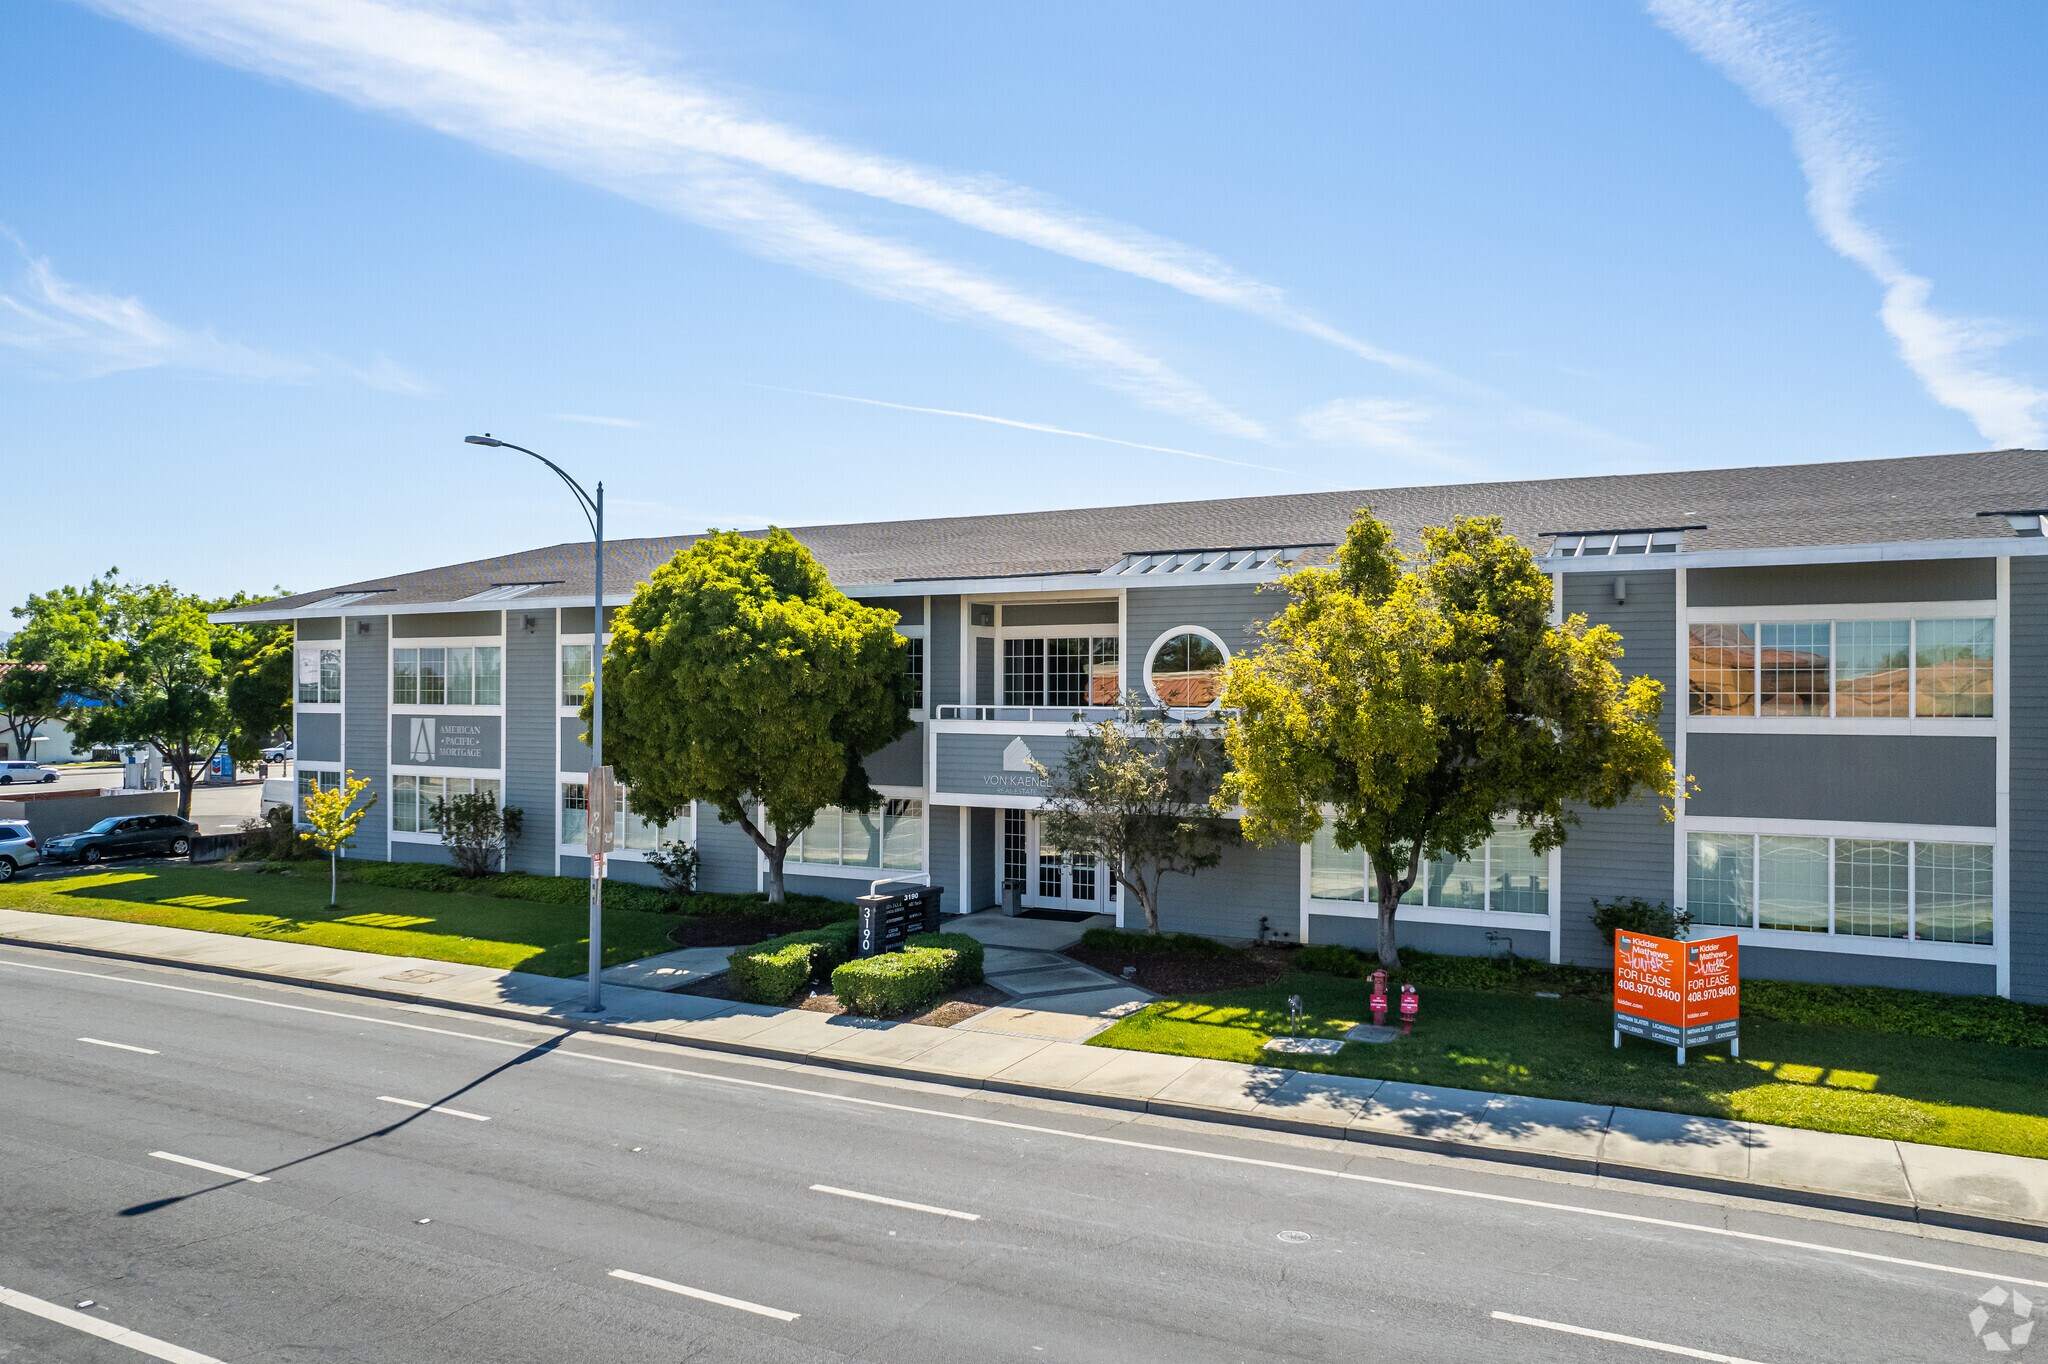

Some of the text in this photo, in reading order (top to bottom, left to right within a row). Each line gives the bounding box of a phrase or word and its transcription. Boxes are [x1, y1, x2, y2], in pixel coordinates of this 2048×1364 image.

[440, 725, 480, 734] AMERICAN
[445, 736, 475, 746] PACIFIC
[440, 747, 481, 757] MORTGAGE
[983, 775, 1052, 788] VON KAENEL
[1014, 788, 1038, 796] ESTATE
[903, 892, 919, 901] 3190
[862, 907, 871, 950] 3190
[1632, 937, 1658, 949] Kidder
[1700, 944, 1719, 952] Kidder
[1632, 945, 1669, 960] Mathews
[1700, 950, 1727, 961] Mathews
[1618, 967, 1671, 988] FOR LEASE
[1688, 974, 1729, 990] FOR LEASE
[1617, 979, 1681, 1002] 408.970.9400
[1687, 985, 1737, 1002] 408.970.9400
[1617, 998, 1643, 1010] kidder.com
[1687, 1011, 1709, 1019] kidder.com
